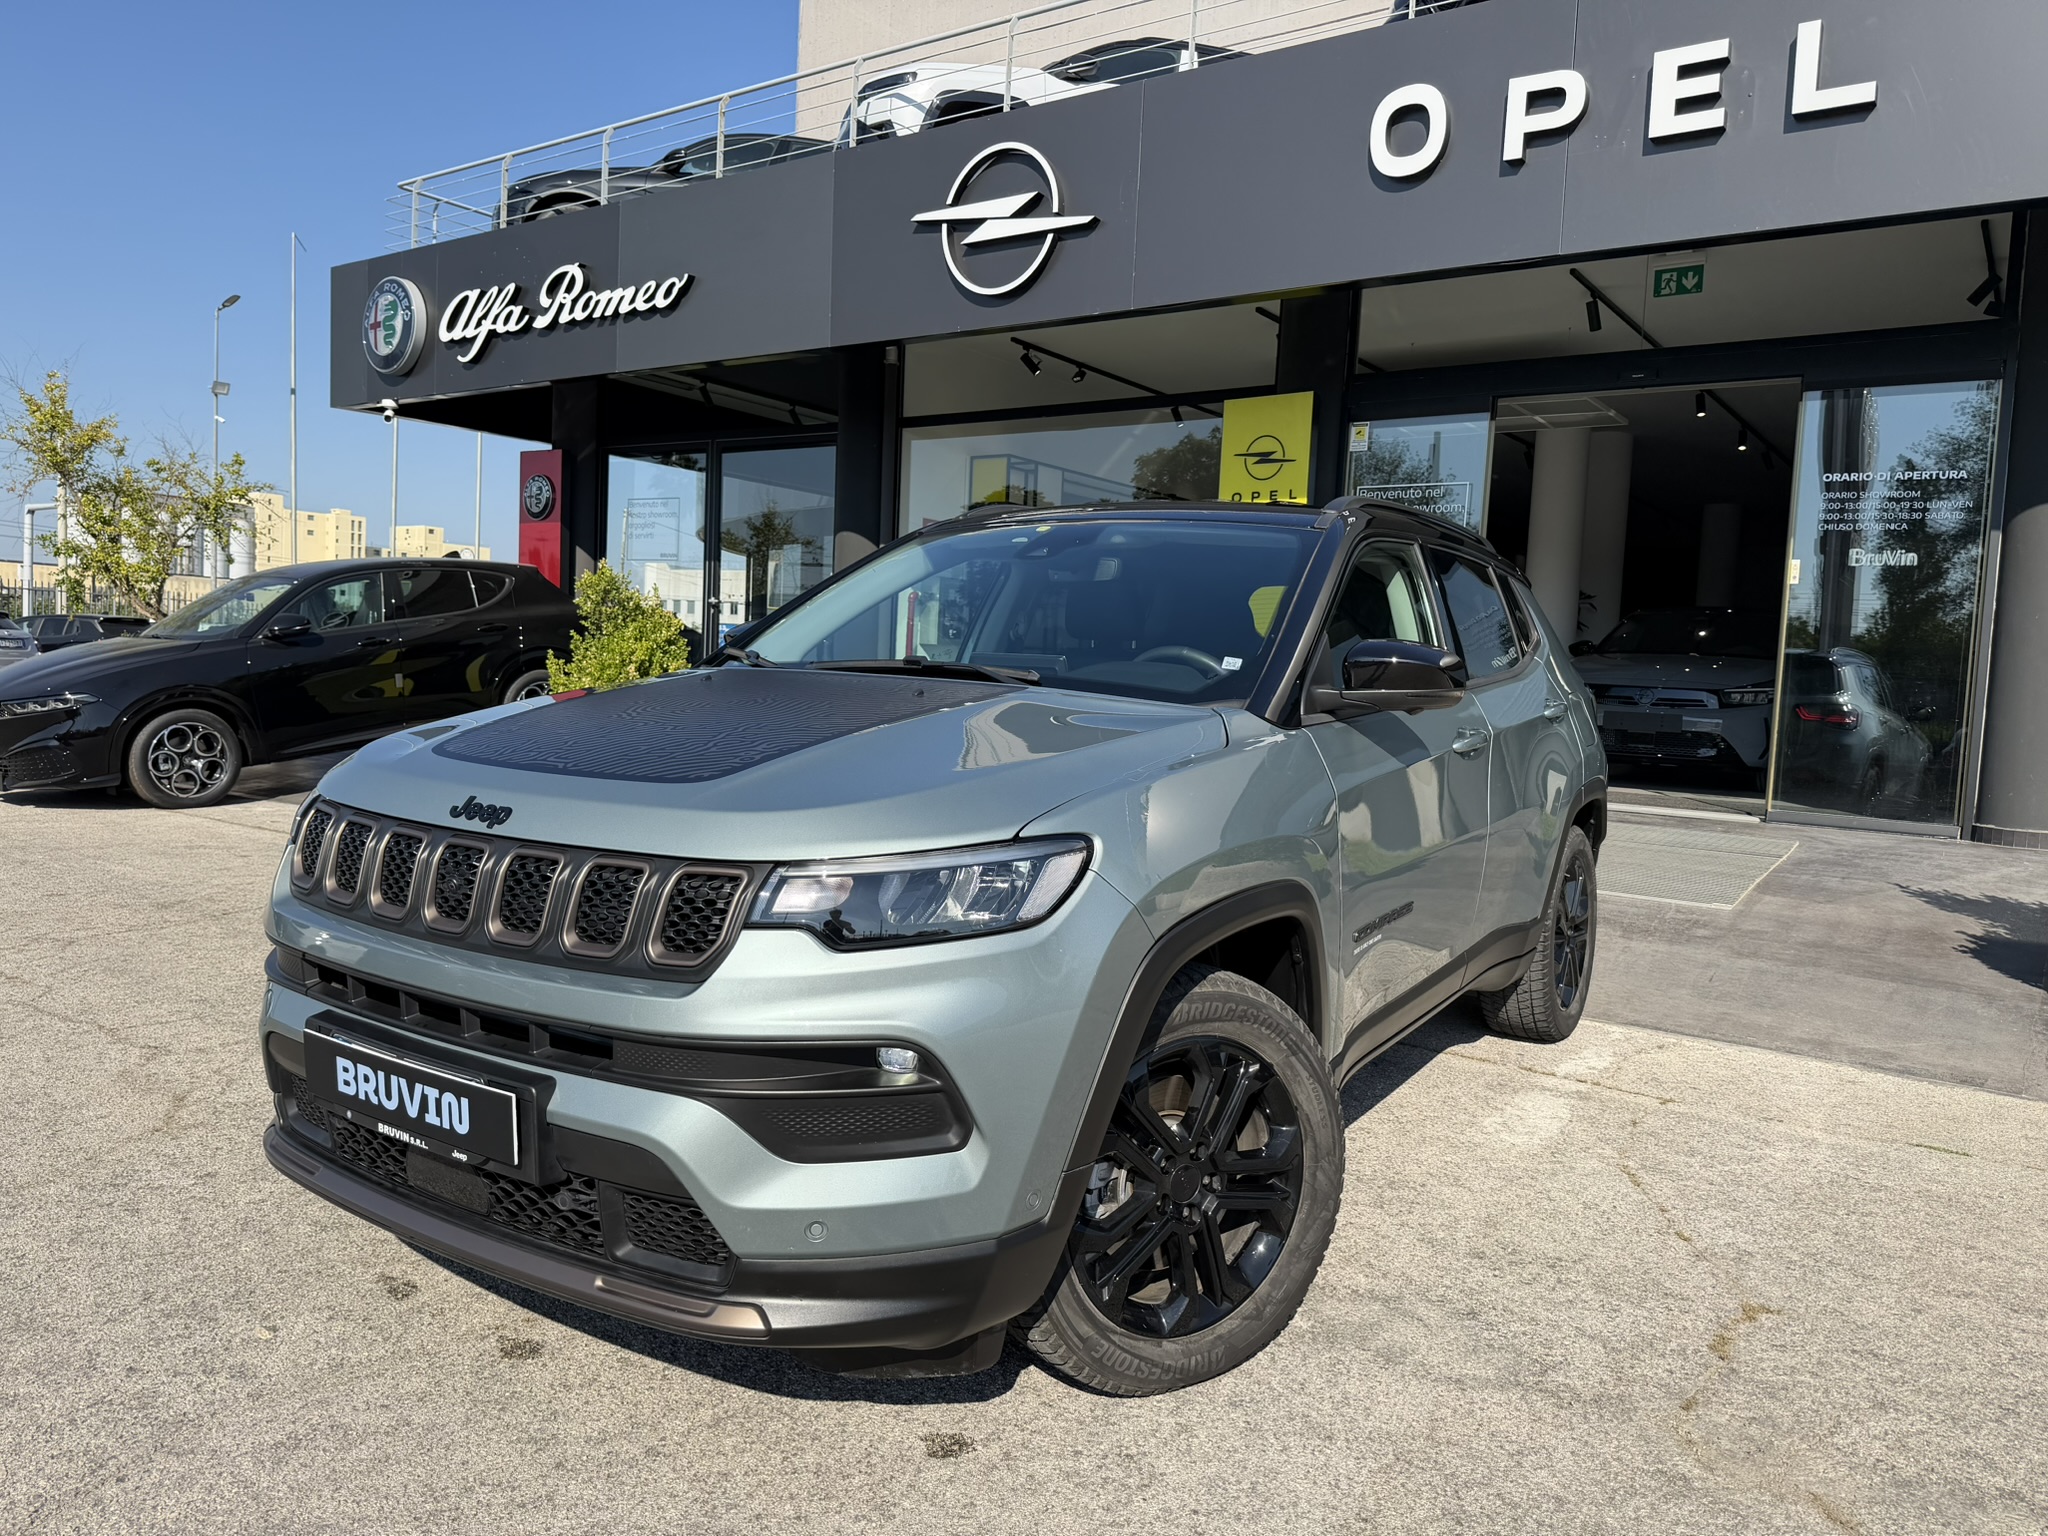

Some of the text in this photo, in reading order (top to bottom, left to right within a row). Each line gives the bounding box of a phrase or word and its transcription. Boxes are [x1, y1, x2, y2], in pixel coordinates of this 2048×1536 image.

[1369, 19, 1877, 178] OPEL
[383, 283, 412, 321] ROMEO
[438, 262, 689, 363] Alfa Romeo
[1822, 470, 1968, 482] ORARIO DI APERTURA
[1231, 489, 1297, 502] OPEL
[1360, 485, 1444, 499] Benvenuto nel
[1859, 490, 1921, 499] SHOWROOM
[1924, 511, 1964, 520] SABATO
[1818, 522, 1909, 531] CHIUSO DOMENICA
[1848, 548, 1918, 567] BruVin
[449, 795, 513, 830] Jeep
[1171, 1001, 1296, 1049] BRIDGESTONE
[335, 1055, 470, 1135] BRUVIN
[377, 1122, 409, 1142] BRUVIN
[451, 1149, 468, 1162] Jeep
[1091, 1342, 1226, 1381] BRIDGESTONE
